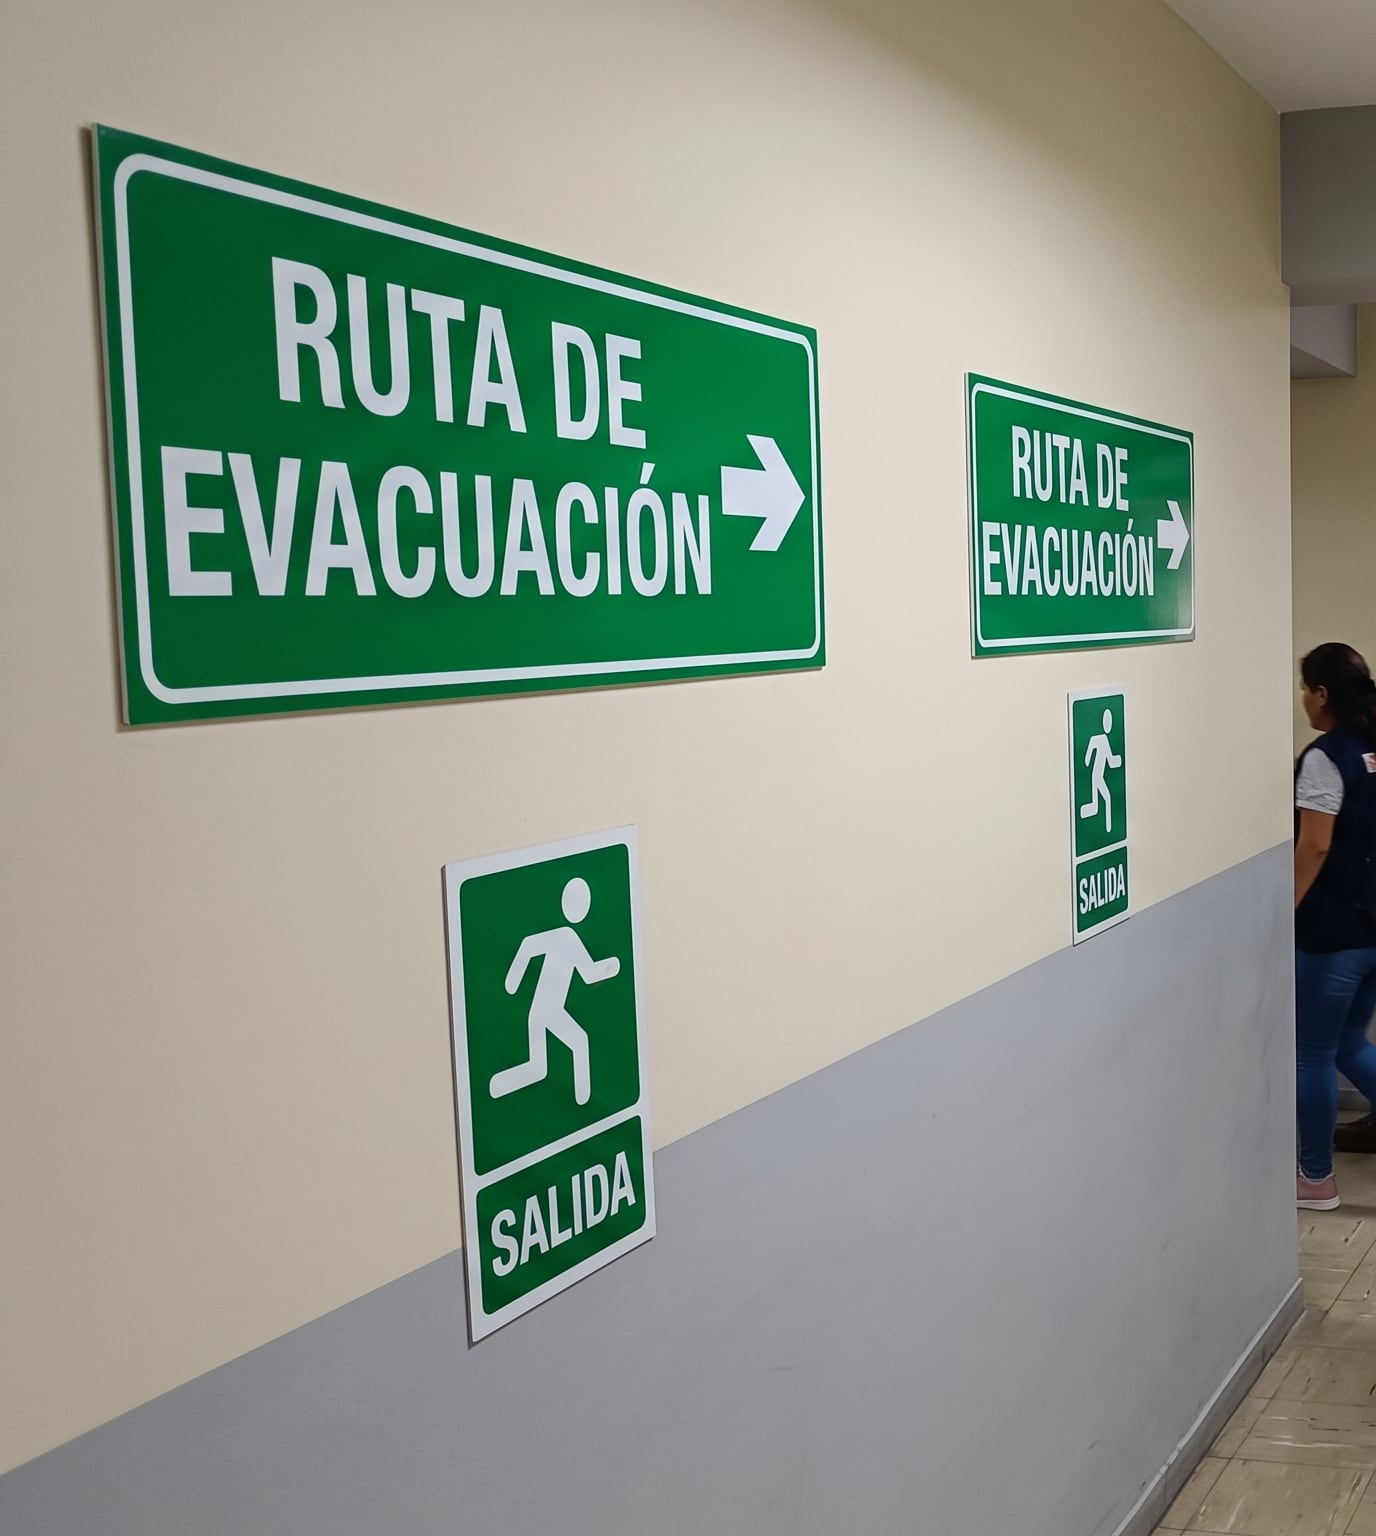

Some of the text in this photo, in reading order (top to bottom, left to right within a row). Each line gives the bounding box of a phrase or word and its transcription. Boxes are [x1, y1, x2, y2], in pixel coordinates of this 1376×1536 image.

[271, 256, 647, 449] RUTA DE
[1012, 425, 1129, 511] RUTA DE
[161, 445, 712, 598] EVACUACIÓN
[982, 518, 1154, 596] EVACUACIÓN
[1079, 863, 1126, 914] SALIDA
[491, 1151, 636, 1277] SALIDA
